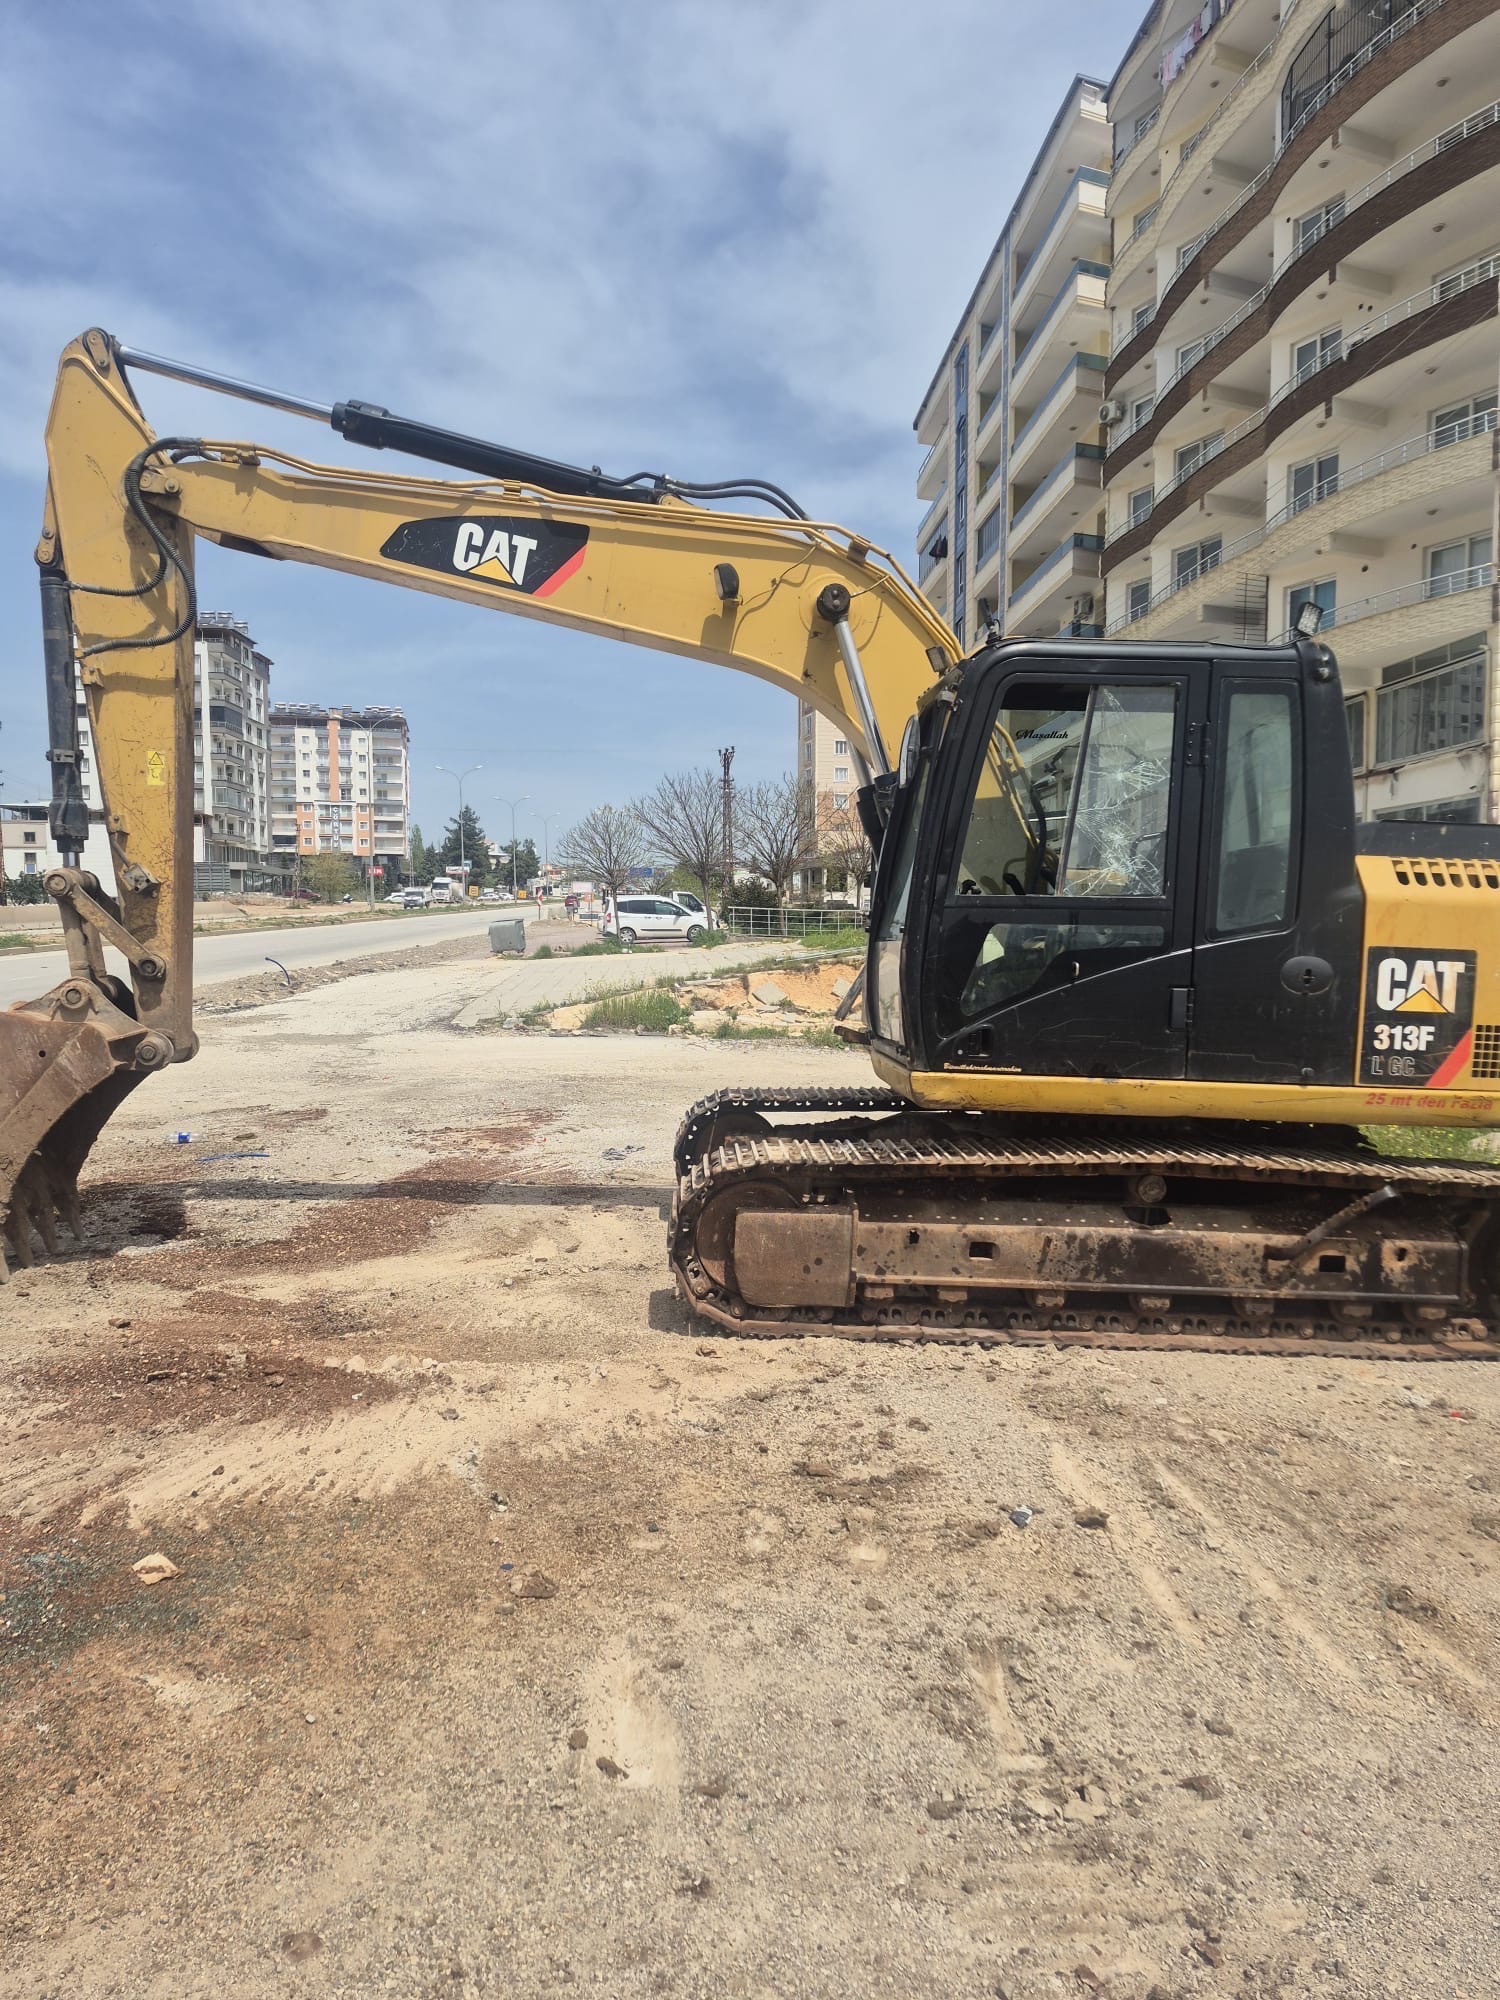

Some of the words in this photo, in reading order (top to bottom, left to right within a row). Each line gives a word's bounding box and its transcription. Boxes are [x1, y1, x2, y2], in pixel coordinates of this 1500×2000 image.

[453, 522, 538, 586] CAT
[1376, 957, 1466, 1014] CAT
[1373, 1024, 1436, 1051] 313F
[1370, 1056, 1384, 1076] L
[1388, 1056, 1416, 1076] GC
[1365, 1092, 1387, 1105] 25
[1390, 1095, 1412, 1107] mt
[1416, 1095, 1446, 1109] den
